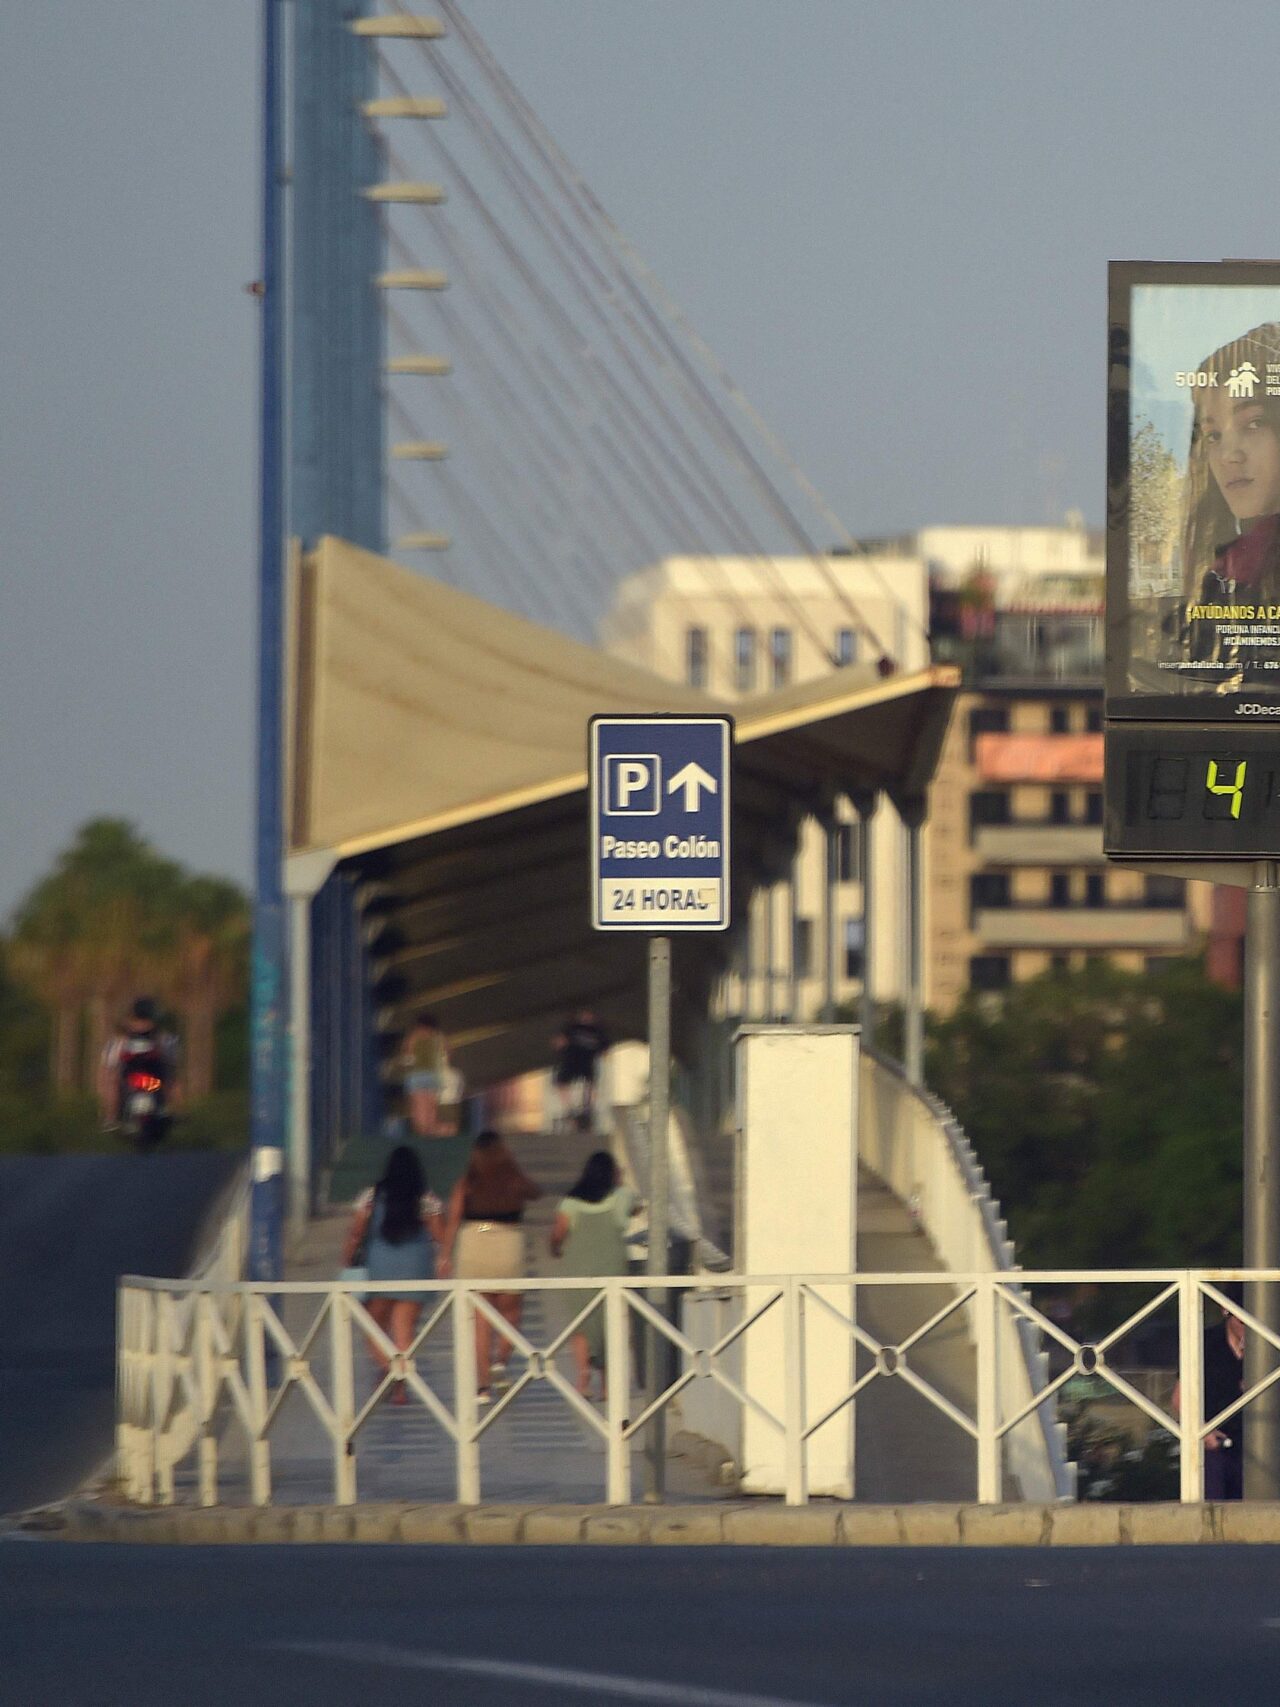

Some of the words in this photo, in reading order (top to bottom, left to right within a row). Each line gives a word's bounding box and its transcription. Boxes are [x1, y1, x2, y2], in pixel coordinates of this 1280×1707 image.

[1175, 371, 1219, 387] 500K
[1266, 375, 1280, 384] DEL
[1257, 605, 1266, 619] A
[1216, 624, 1231, 634] POR
[1232, 624, 1249, 634] UNA
[618, 762, 650, 807] P
[602, 835, 661, 858] Paseo
[664, 834, 720, 858] Colón
[613, 889, 635, 910] 24
